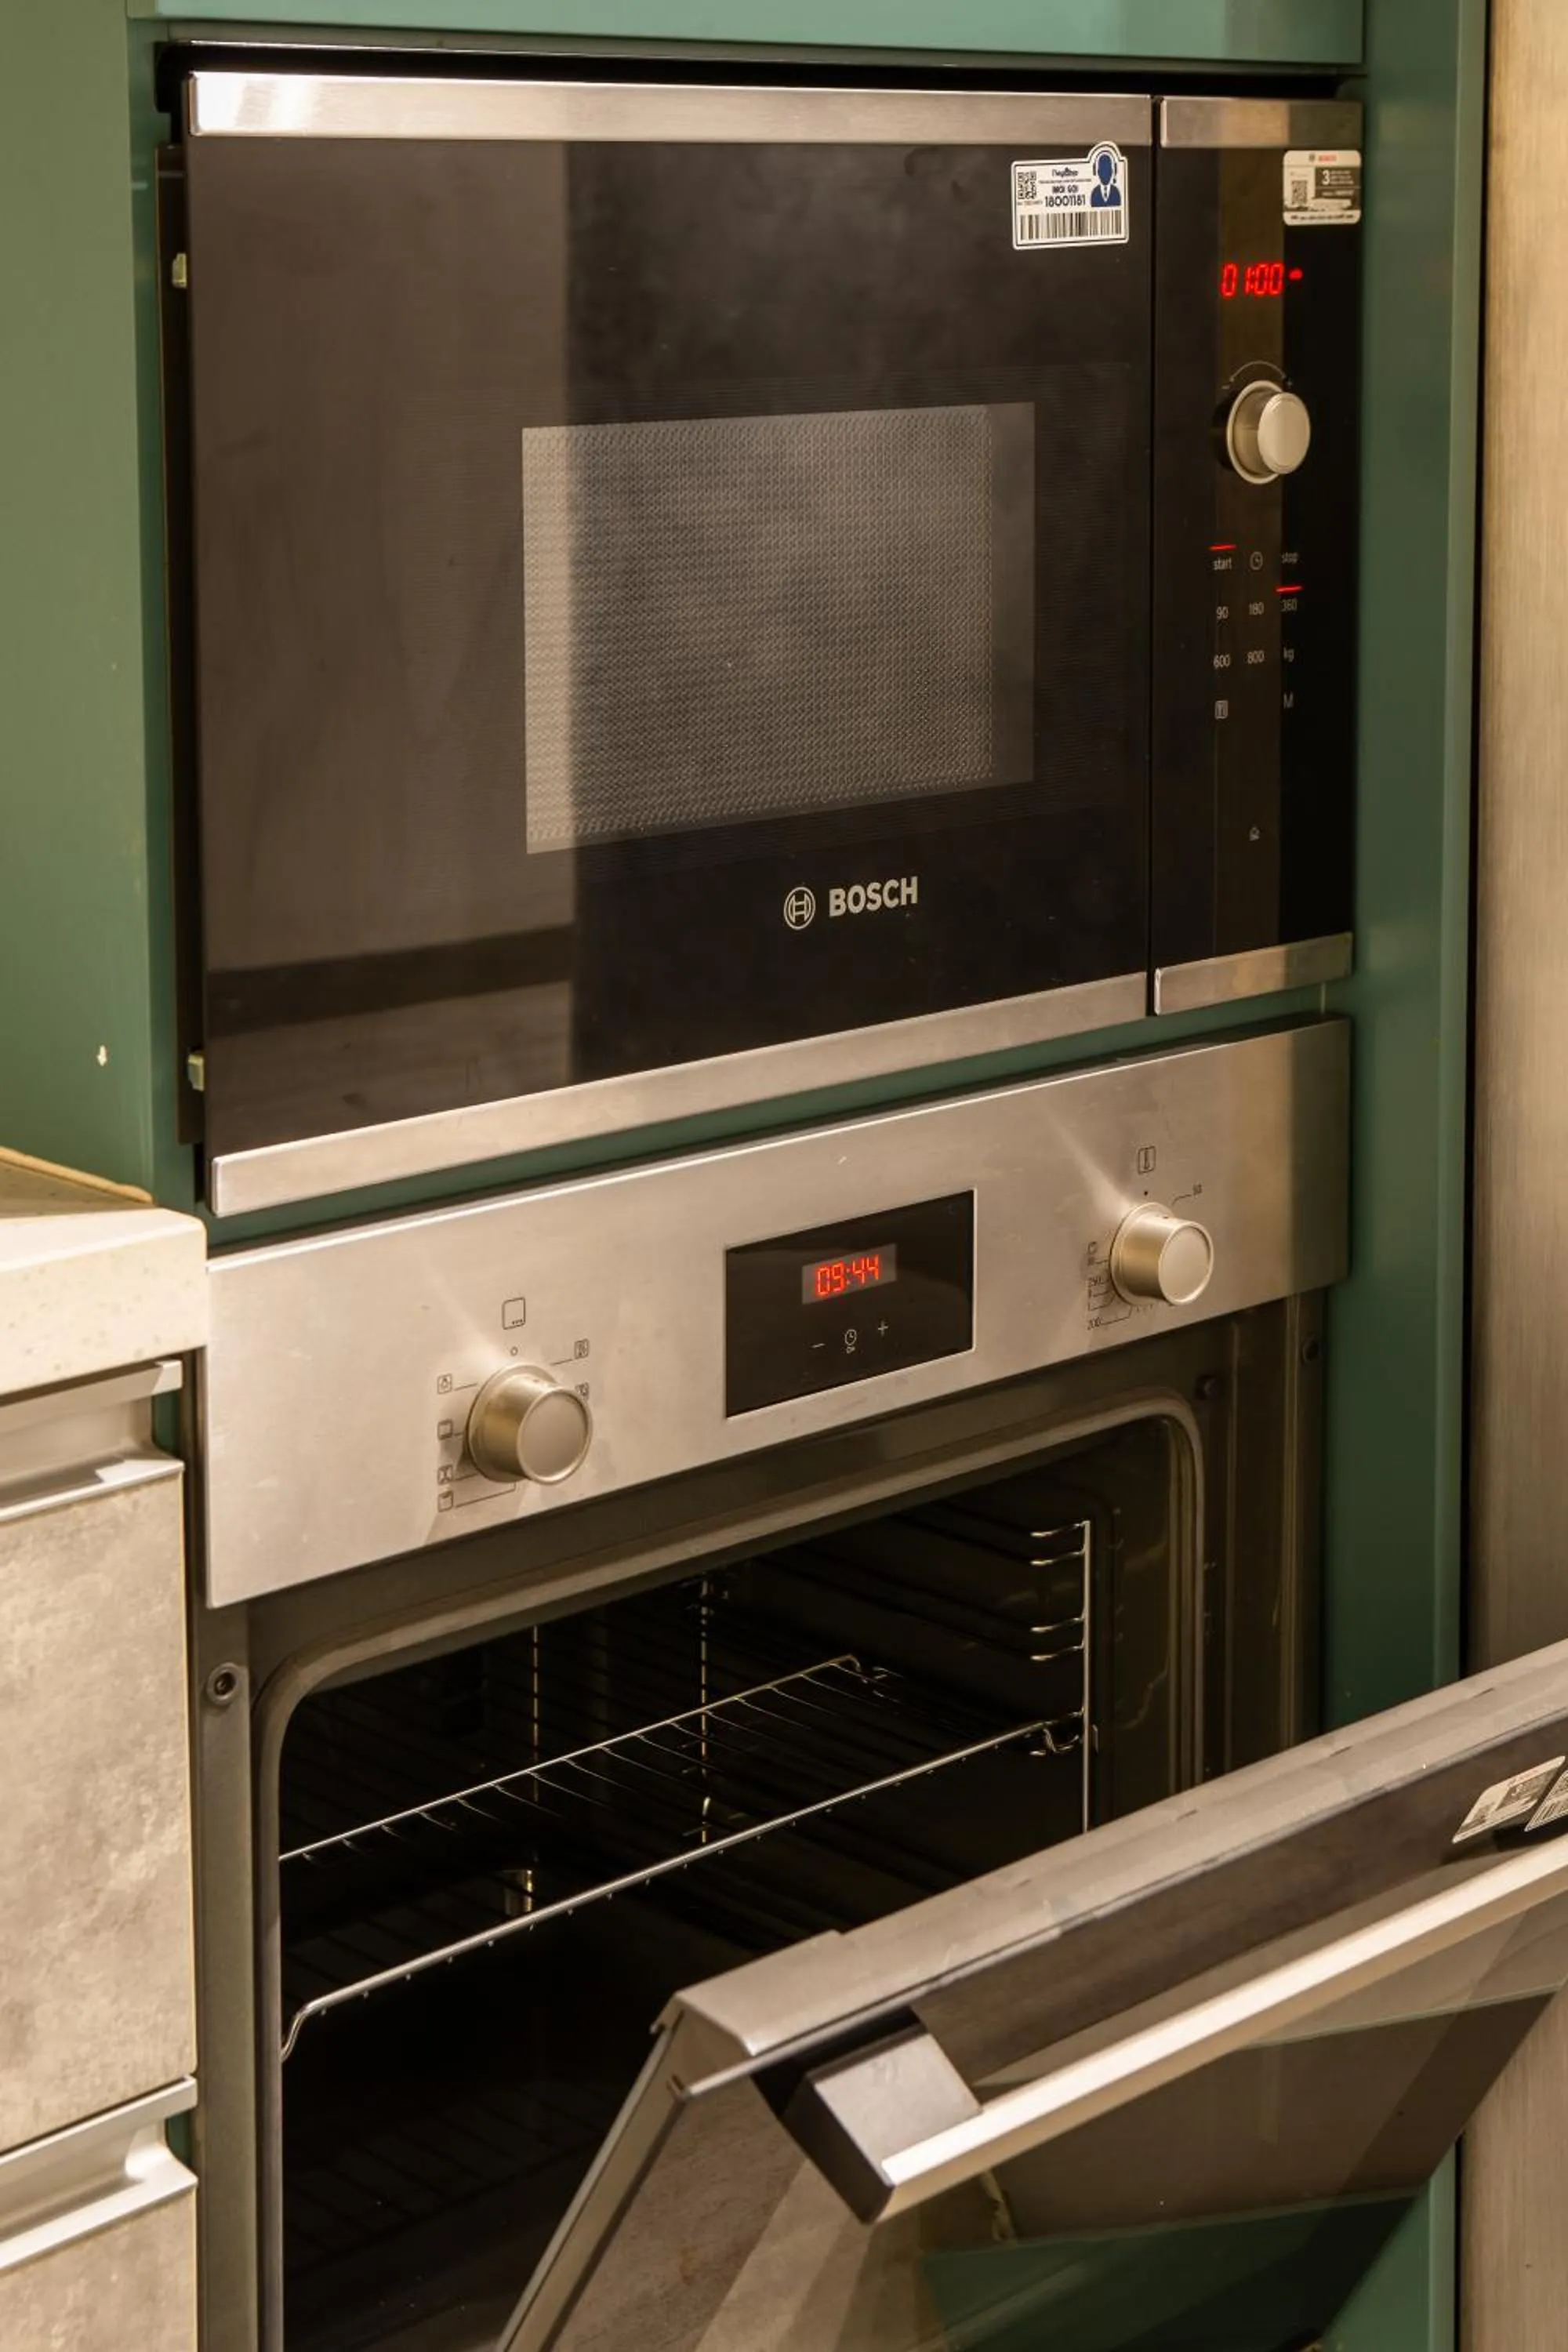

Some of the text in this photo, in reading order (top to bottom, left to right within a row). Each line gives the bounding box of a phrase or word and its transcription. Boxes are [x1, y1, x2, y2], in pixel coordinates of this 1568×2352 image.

[1213, 557, 1232, 570] start
[1248, 601, 1264, 615] 180
[1280, 598, 1298, 612] 360
[1216, 606, 1229, 619] 90
[1247, 650, 1265, 664] 800
[1283, 647, 1294, 662] kg
[1213, 655, 1231, 669] 600
[1283, 692, 1294, 709] M
[829, 877, 918, 916] BOSCH
[815, 1254, 880, 1297] 09:44
